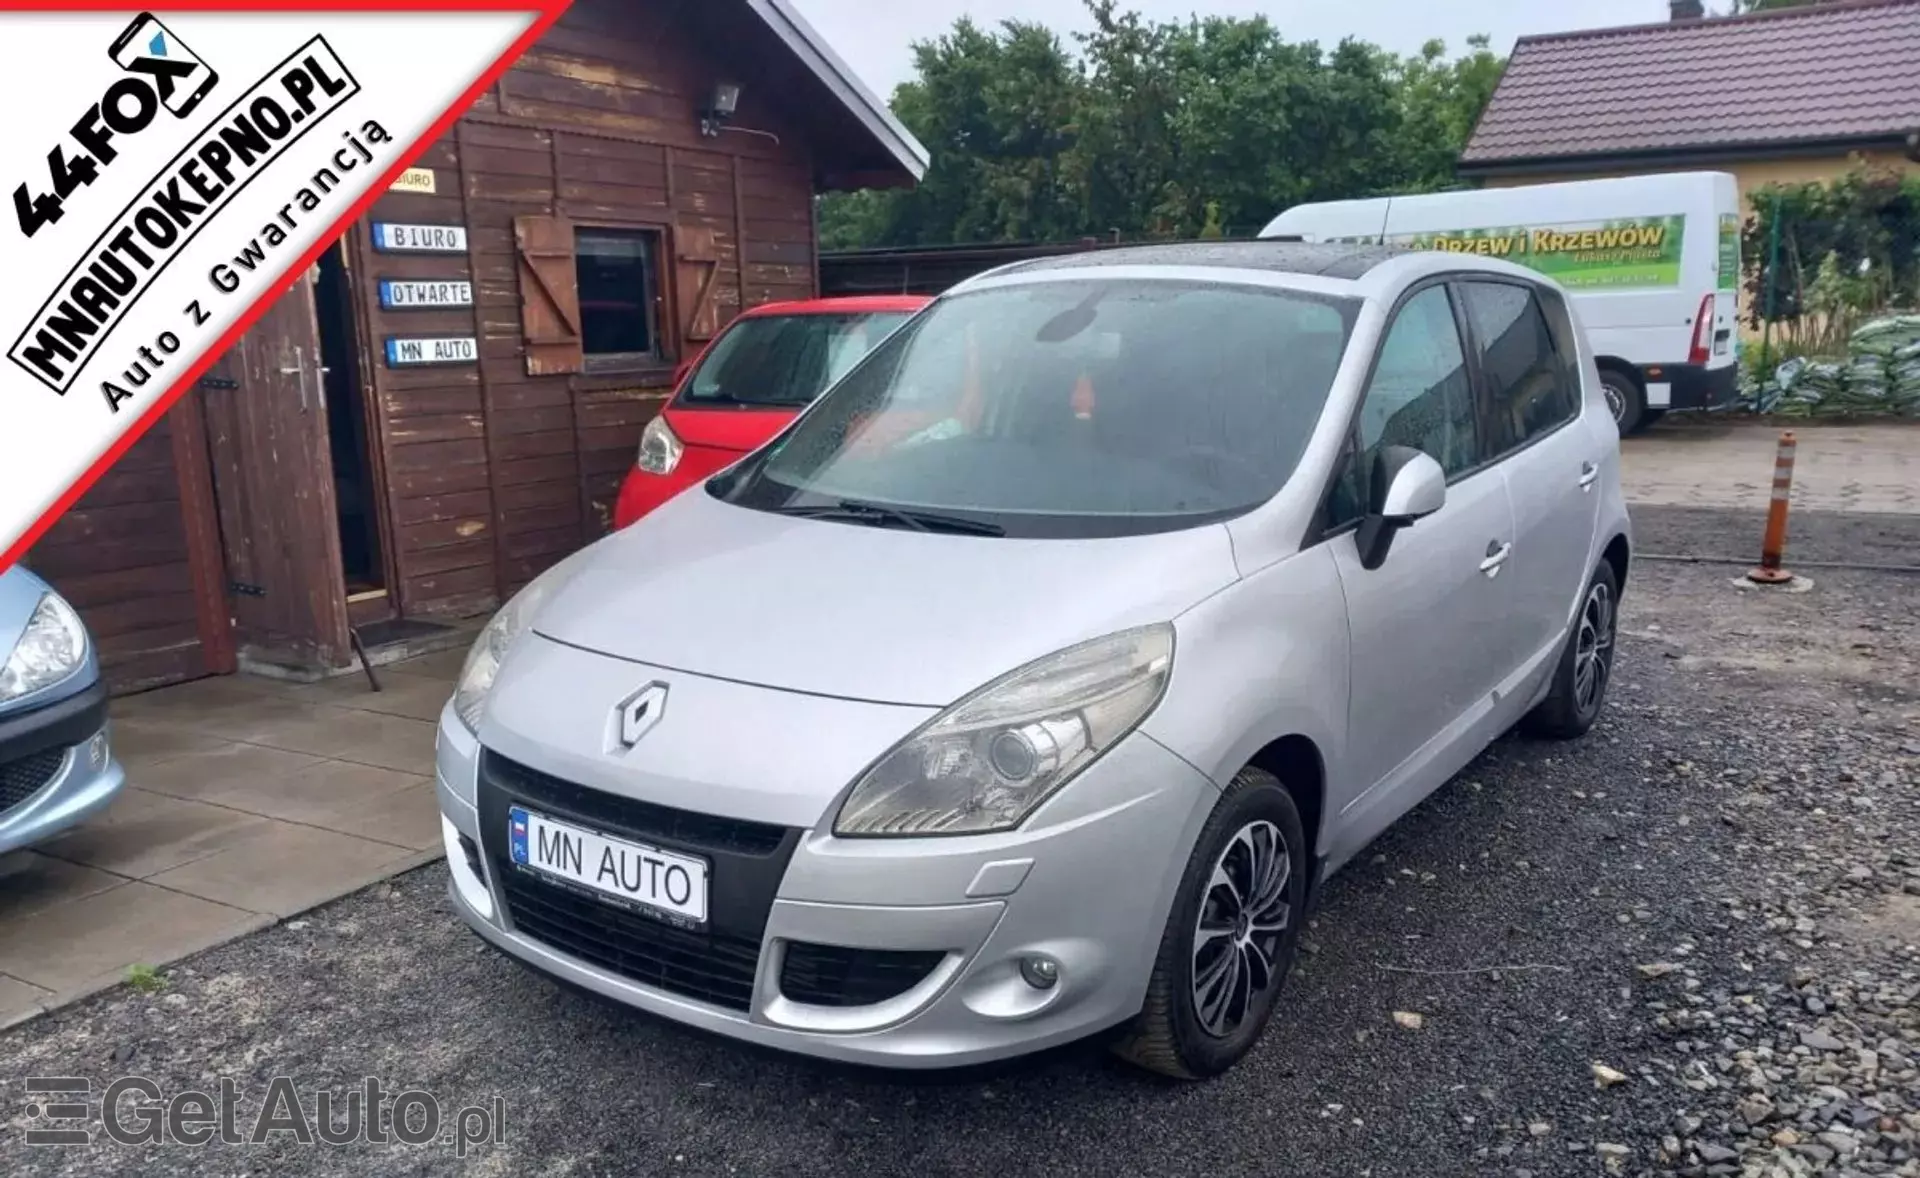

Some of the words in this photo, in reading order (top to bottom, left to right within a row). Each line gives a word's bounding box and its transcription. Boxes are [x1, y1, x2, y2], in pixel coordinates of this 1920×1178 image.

[394, 226, 457, 248] BIURO
[1533, 223, 1665, 255] KRZEWÓW
[392, 283, 471, 304] OTWARTE
[401, 341, 423, 360] MN
[434, 339, 473, 360] AUTO
[538, 824, 583, 877] MN
[597, 844, 692, 906] AUTO
